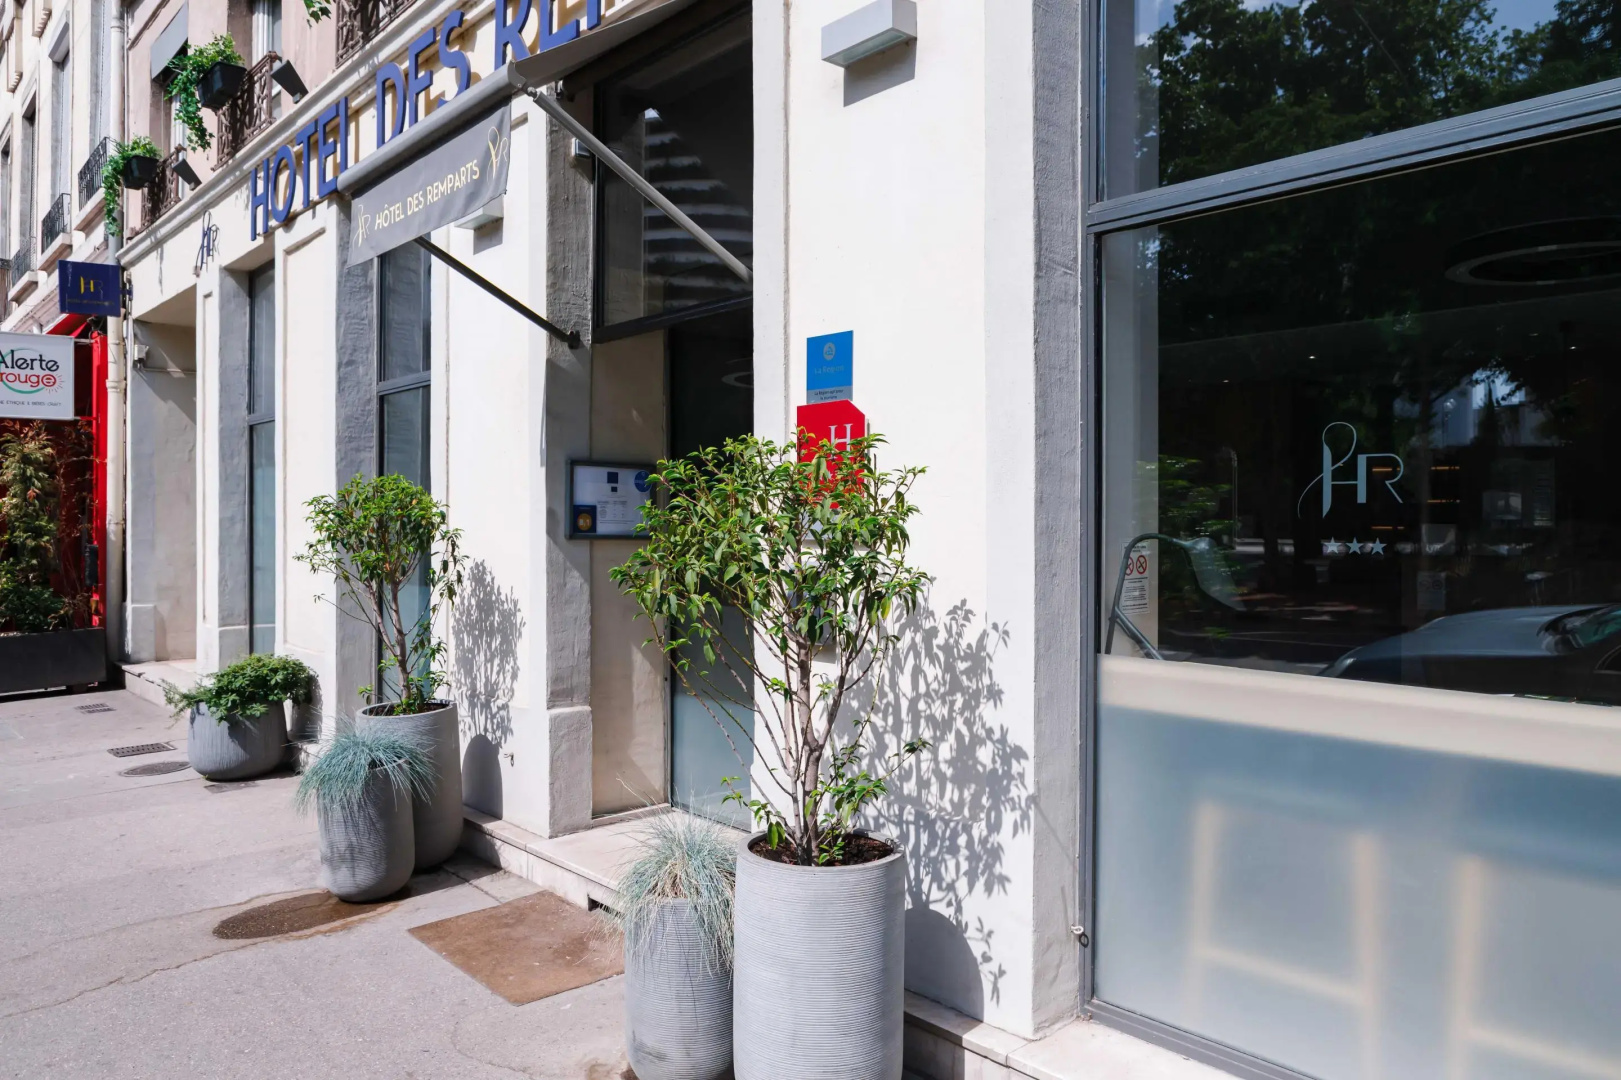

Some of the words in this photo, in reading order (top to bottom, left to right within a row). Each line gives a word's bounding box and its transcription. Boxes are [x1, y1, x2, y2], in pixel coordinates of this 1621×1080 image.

[374, 202, 405, 230] HÔTEL
[407, 192, 425, 215] DES
[427, 160, 480, 206] REMPARTS
[828, 423, 853, 459] H
